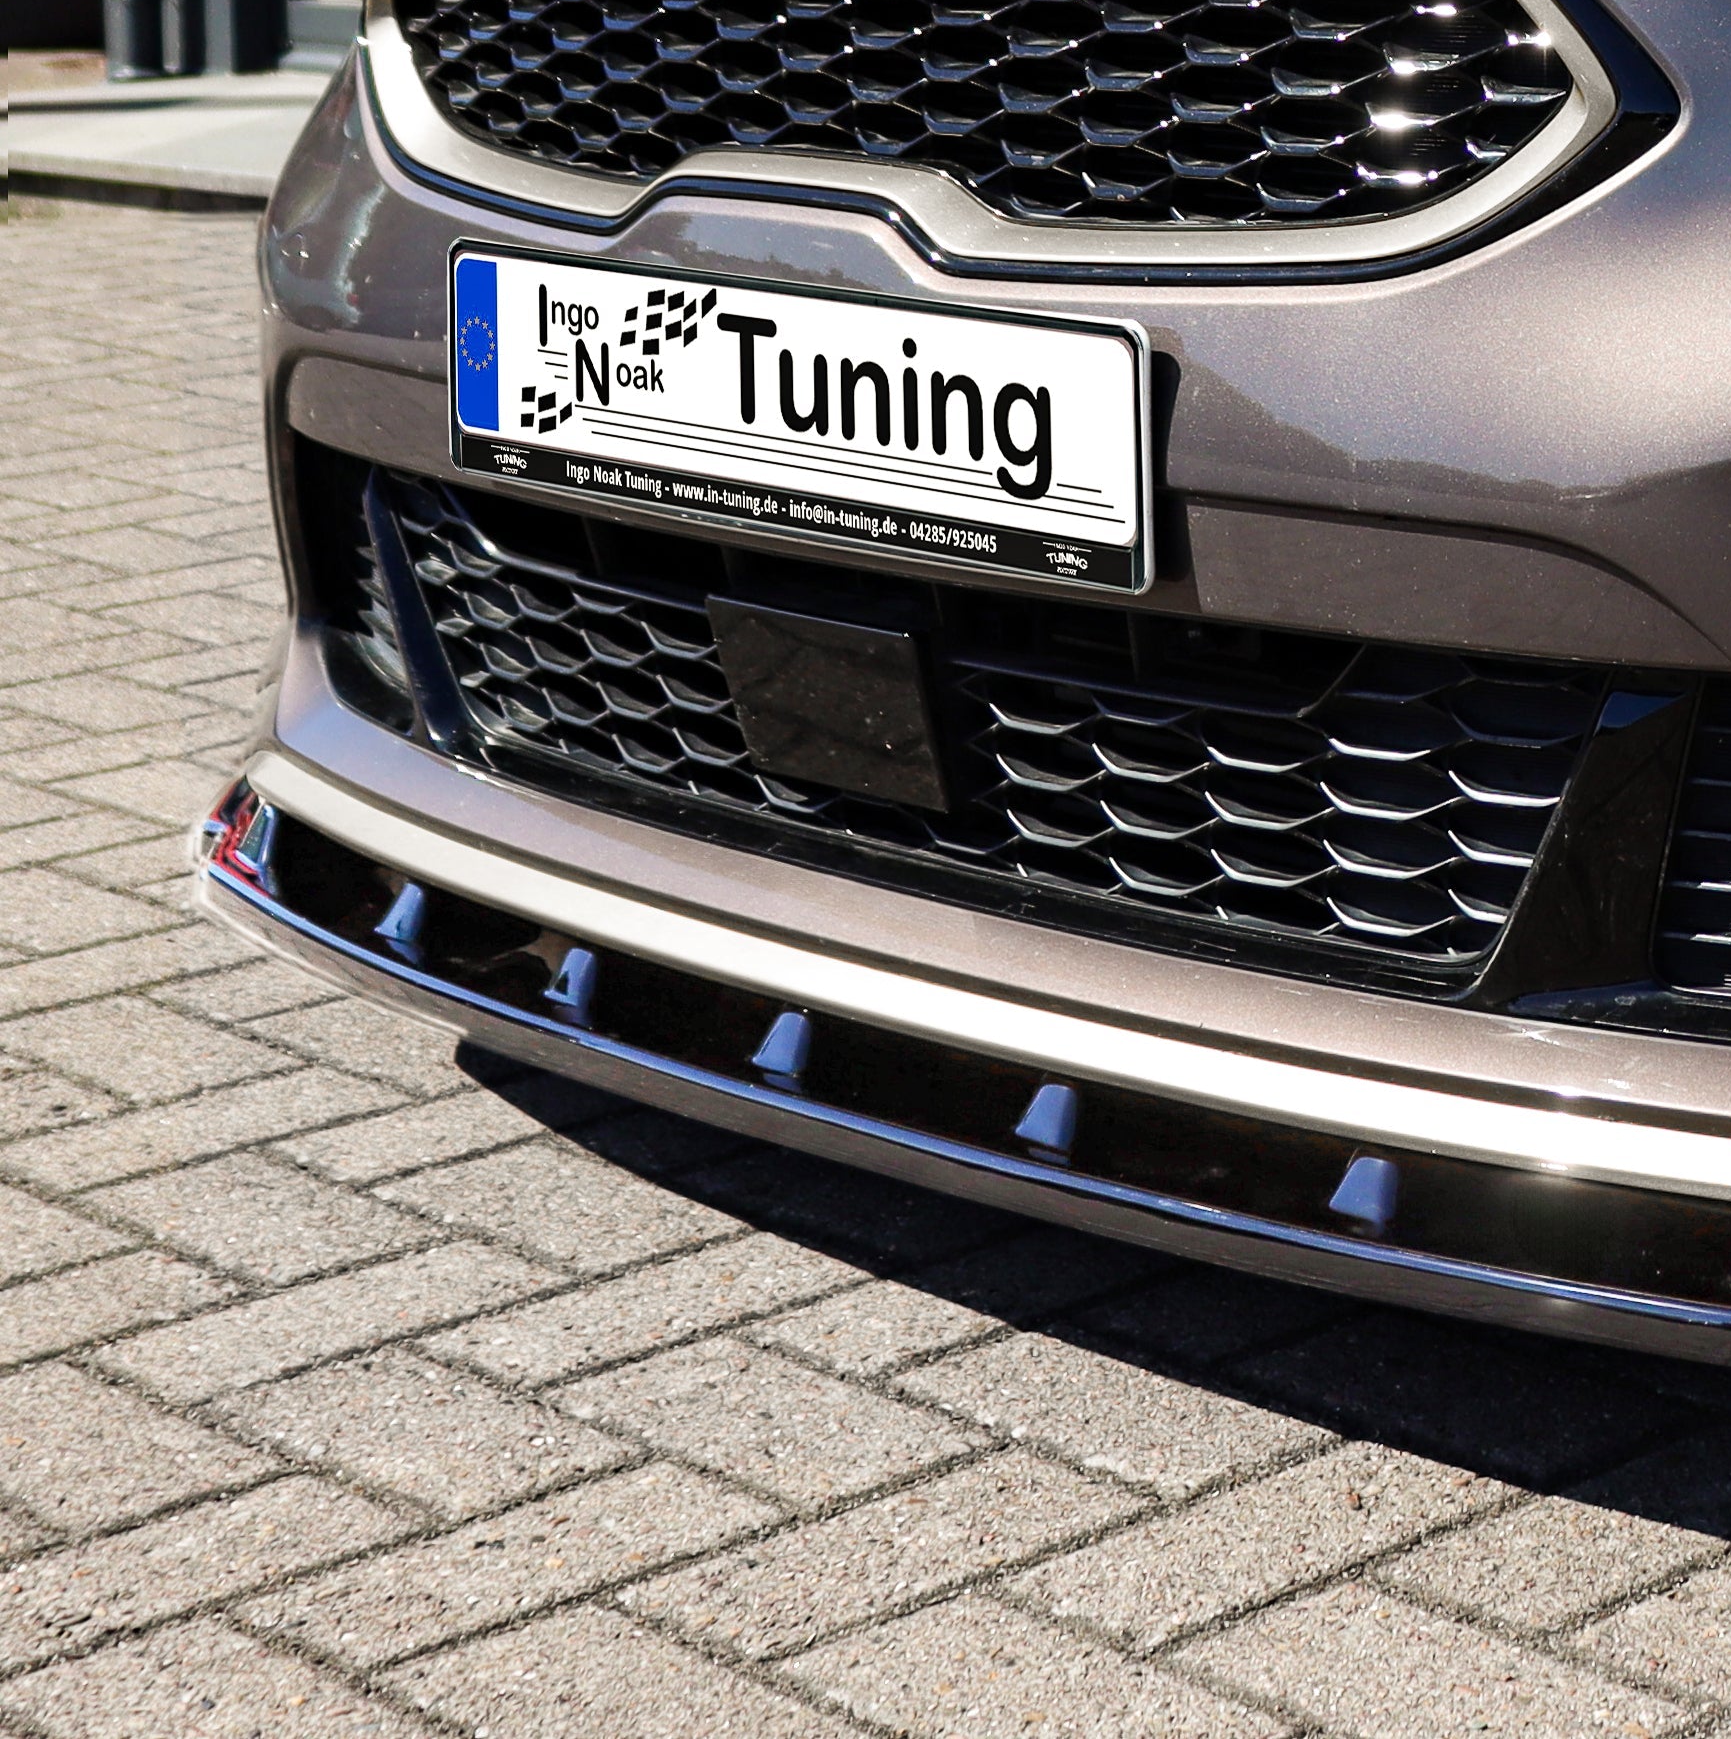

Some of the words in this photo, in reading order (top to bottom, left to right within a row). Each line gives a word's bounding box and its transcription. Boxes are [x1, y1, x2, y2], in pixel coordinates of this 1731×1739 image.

[538, 283, 600, 347] Ingo
[575, 339, 665, 407] Noak
[716, 313, 1052, 500] Tuning
[493, 453, 528, 470] TUNING
[566, 460, 590, 484] Ingo
[593, 465, 622, 487] Noak
[624, 471, 663, 498] Tuning
[672, 481, 778, 516] www.in-tuning.de
[789, 498, 898, 537] info@in-tuning.de
[909, 521, 997, 554] 04285/925045
[1045, 552, 1088, 570] TUNING
